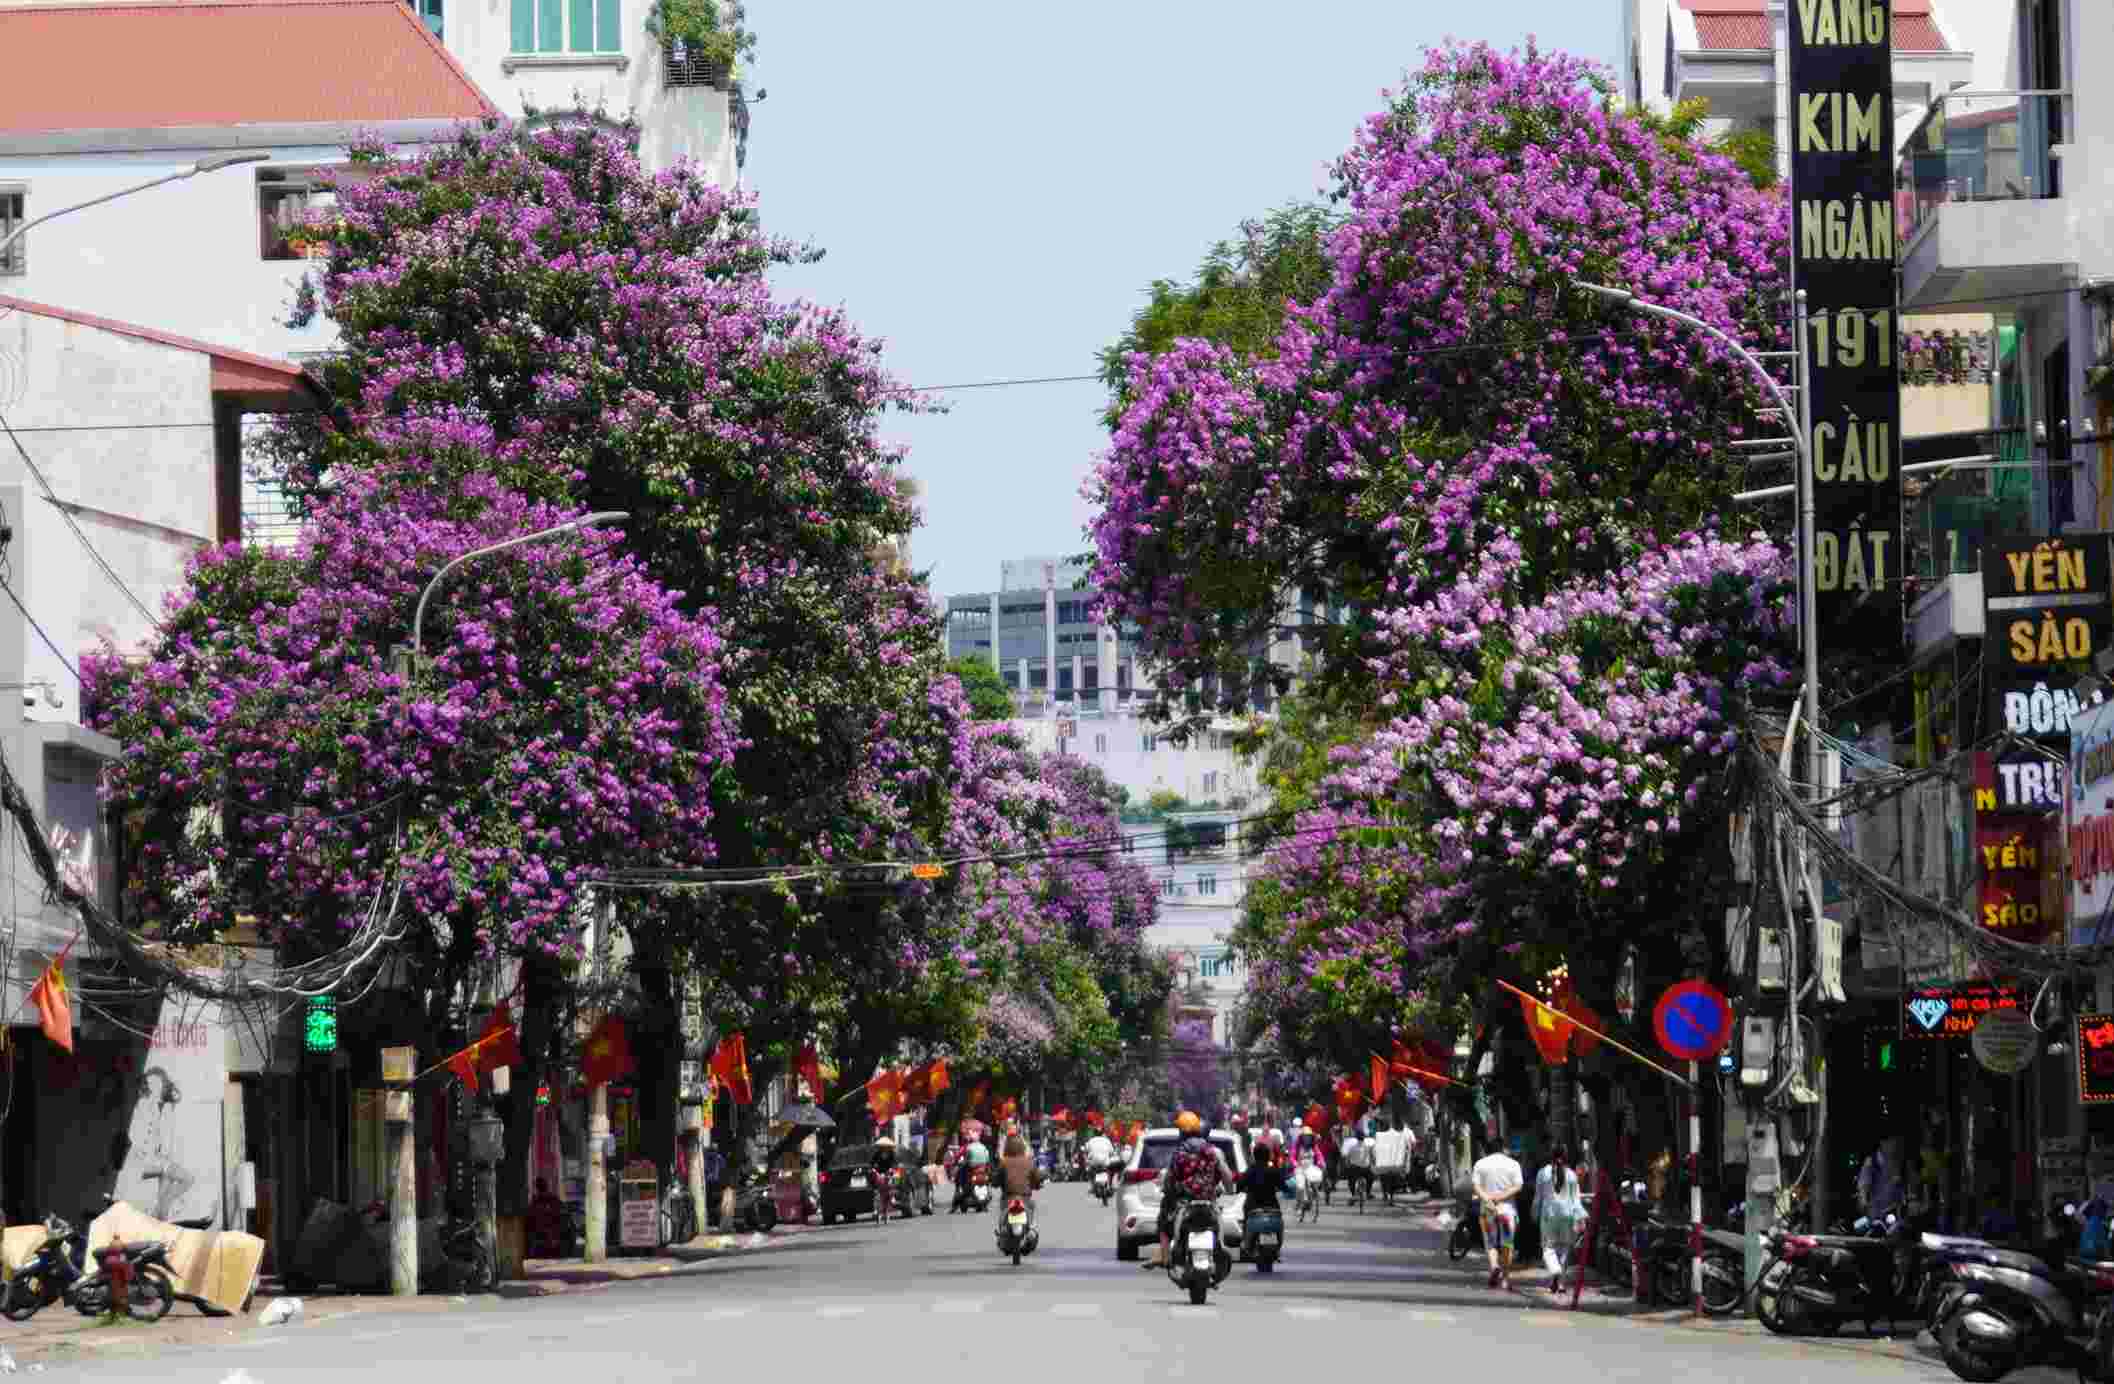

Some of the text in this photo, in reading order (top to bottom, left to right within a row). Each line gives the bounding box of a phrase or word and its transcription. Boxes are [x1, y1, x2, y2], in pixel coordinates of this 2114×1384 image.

[1799, 93, 1881, 152] KIM
[1800, 191, 1893, 260] NGÂN
[1808, 307, 1890, 367] 191
[1813, 404, 1889, 482] CẦU
[1814, 511, 1889, 592] ĐẤT
[2006, 538, 2087, 592] YẾN
[2010, 609, 2091, 661] SÀO
